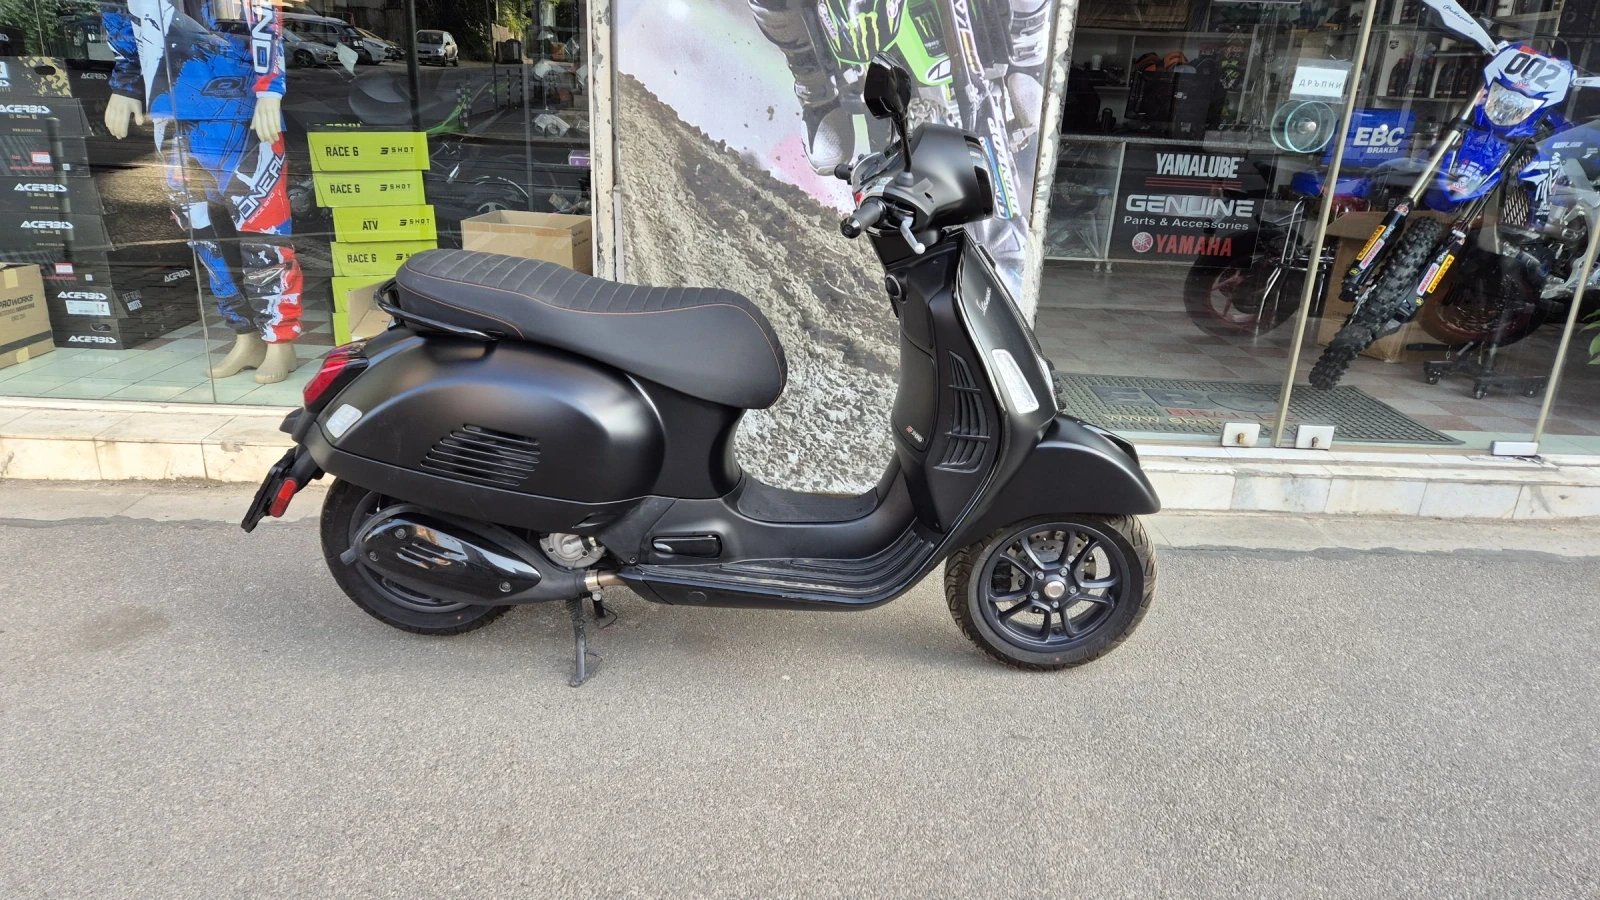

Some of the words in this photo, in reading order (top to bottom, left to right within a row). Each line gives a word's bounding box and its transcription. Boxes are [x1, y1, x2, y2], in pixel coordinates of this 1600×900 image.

[80, 72, 108, 80] ACERBIS
[1504, 52, 1561, 90] 002
[1298, 78, 1343, 89] ДРЪПНИ
[0, 104, 51, 114] ACERBIS
[1353, 126, 1405, 147] EBC
[325, 146, 351, 157] RACE
[352, 146, 359, 157] 6
[1366, 146, 1399, 154] BRAKES
[1156, 153, 1241, 179] YAMALUBE
[13, 182, 68, 192] ACERBIS
[330, 184, 352, 194] RACE
[354, 183, 361, 194] 6
[1125, 194, 1255, 218] GENUINE
[20, 220, 74, 230] ACERBIS
[362, 220, 379, 231] ATV
[1123, 215, 1156, 226] Parts
[1159, 217, 1168, 226] &
[1171, 218, 1249, 231] Accessories
[1156, 234, 1232, 257] YAMAHA
[347, 254, 369, 264] RACE
[370, 253, 377, 263] 6
[57, 291, 108, 300] ACERBIS
[68, 335, 117, 344] ACERBIS
